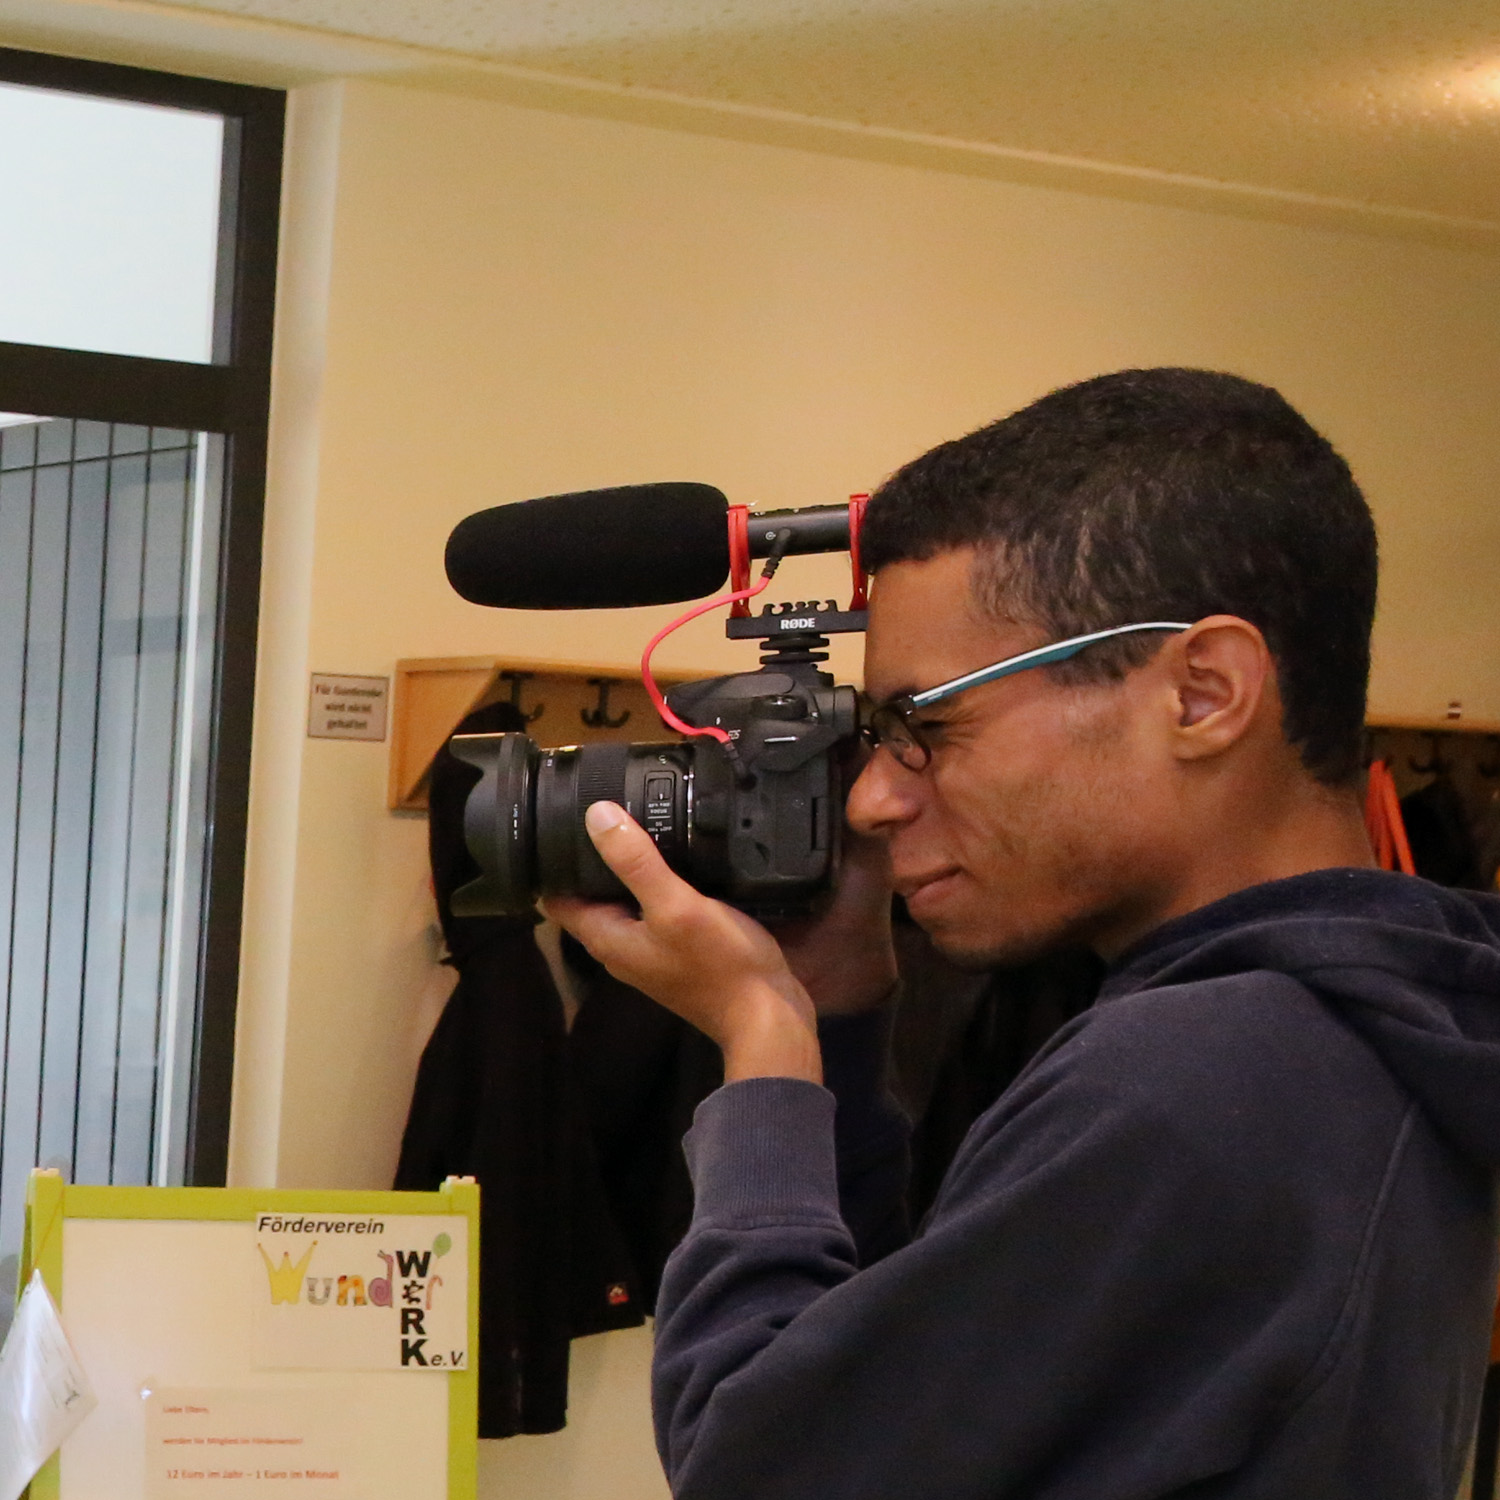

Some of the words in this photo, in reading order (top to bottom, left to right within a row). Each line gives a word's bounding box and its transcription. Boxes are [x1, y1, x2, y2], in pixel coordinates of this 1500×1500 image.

[780, 617, 816, 630] RØDE
[257, 1216, 385, 1235] Förderverein
[430, 1351, 464, 1367] e.V.
[167, 1470, 179, 1480] 12
[255, 1470, 262, 1480] 1
[264, 1470, 287, 1480] Euro
